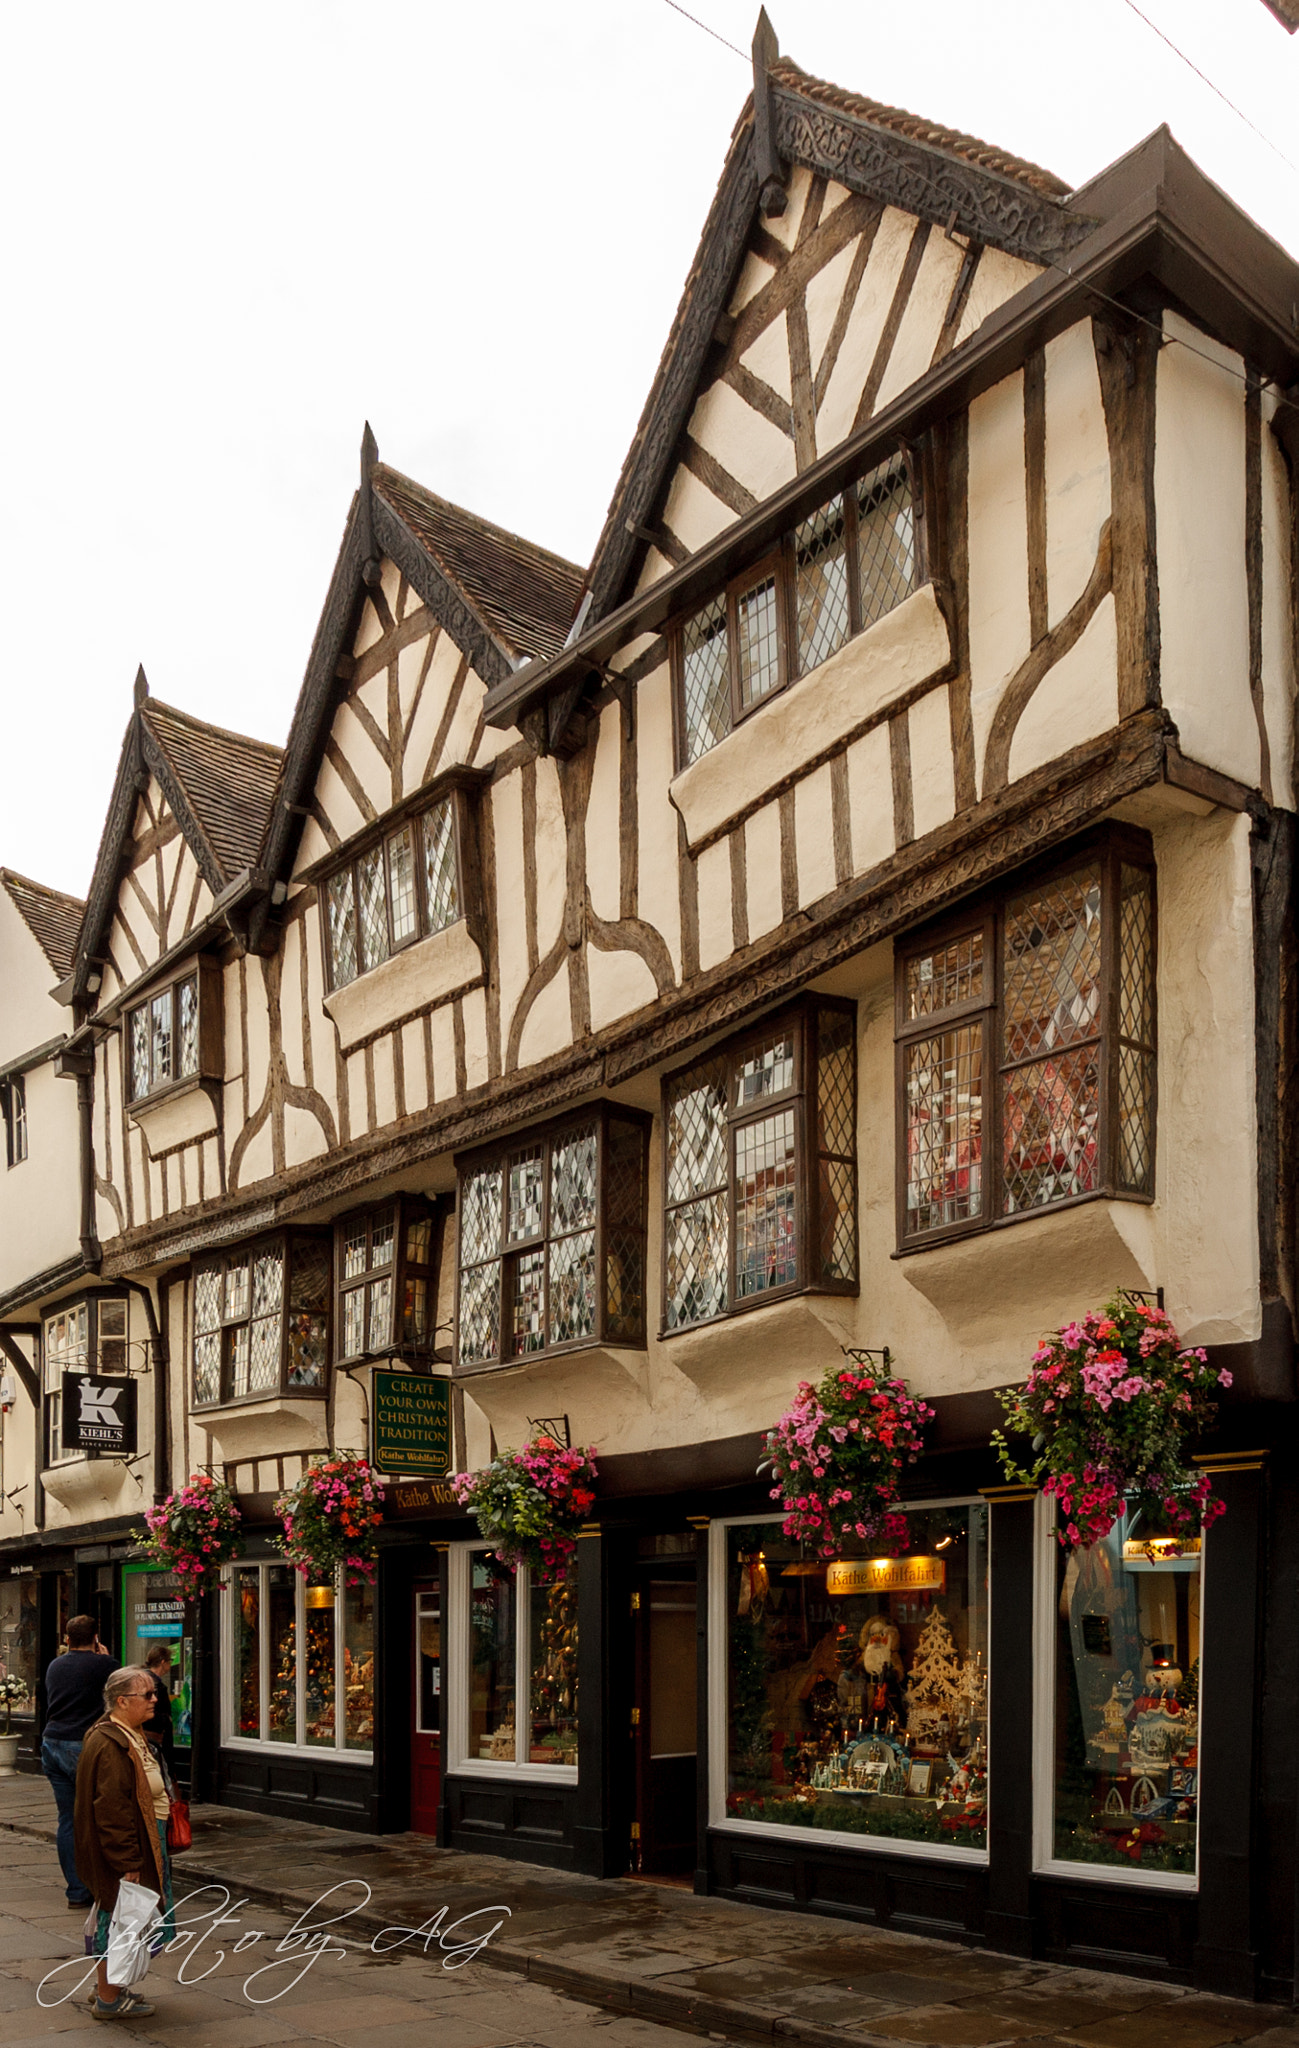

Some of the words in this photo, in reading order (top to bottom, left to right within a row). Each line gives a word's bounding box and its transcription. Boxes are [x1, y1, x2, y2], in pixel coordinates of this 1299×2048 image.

[391, 1380, 435, 1395] CREATE
[379, 1395, 414, 1408] YOUR
[416, 1399, 447, 1411] OWN
[378, 1410, 448, 1427] CHRISTMAS
[79, 1428, 124, 1440] KIEHL'S
[379, 1426, 447, 1442] TRADITION
[832, 1569, 868, 1586] Käthe
[872, 1566, 937, 1583] Wohlfahrt
[134, 1604, 147, 1612] FEEL
[148, 1603, 158, 1612] THE
[158, 1601, 185, 1611] SENSATION
